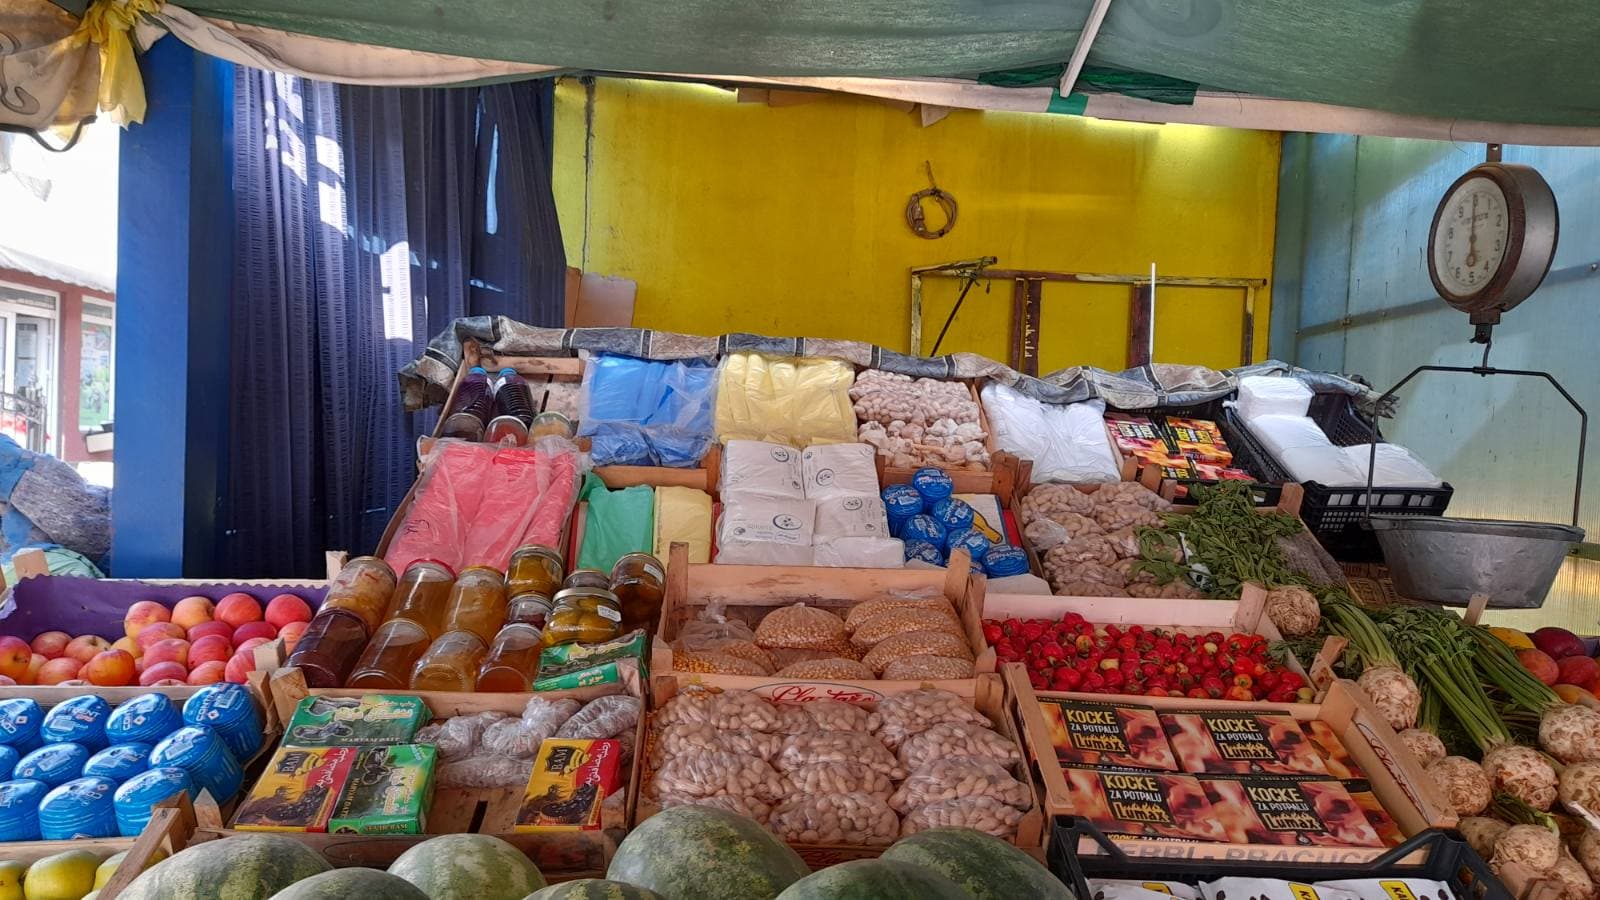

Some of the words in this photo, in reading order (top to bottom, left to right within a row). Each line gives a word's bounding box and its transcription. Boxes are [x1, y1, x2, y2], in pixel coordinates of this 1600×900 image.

[1065, 709, 1116, 725] KOCKE
[1071, 723, 1081, 731] ZA
[1083, 724, 1119, 734] POTPALU
[1207, 718, 1259, 733] KOCKE
[1216, 732, 1226, 740] ZA
[1227, 733, 1263, 741] POTPALU
[281, 753, 302, 772] BAM
[551, 749, 568, 770] BAM
[1104, 774, 1158, 791] KOCKE
[1109, 790, 1122, 799] ZA
[1123, 791, 1162, 802] POTPALU
[1247, 786, 1303, 802] KOCKE
[1256, 802, 1268, 811] ZA
[1269, 802, 1309, 812] POTPALU
